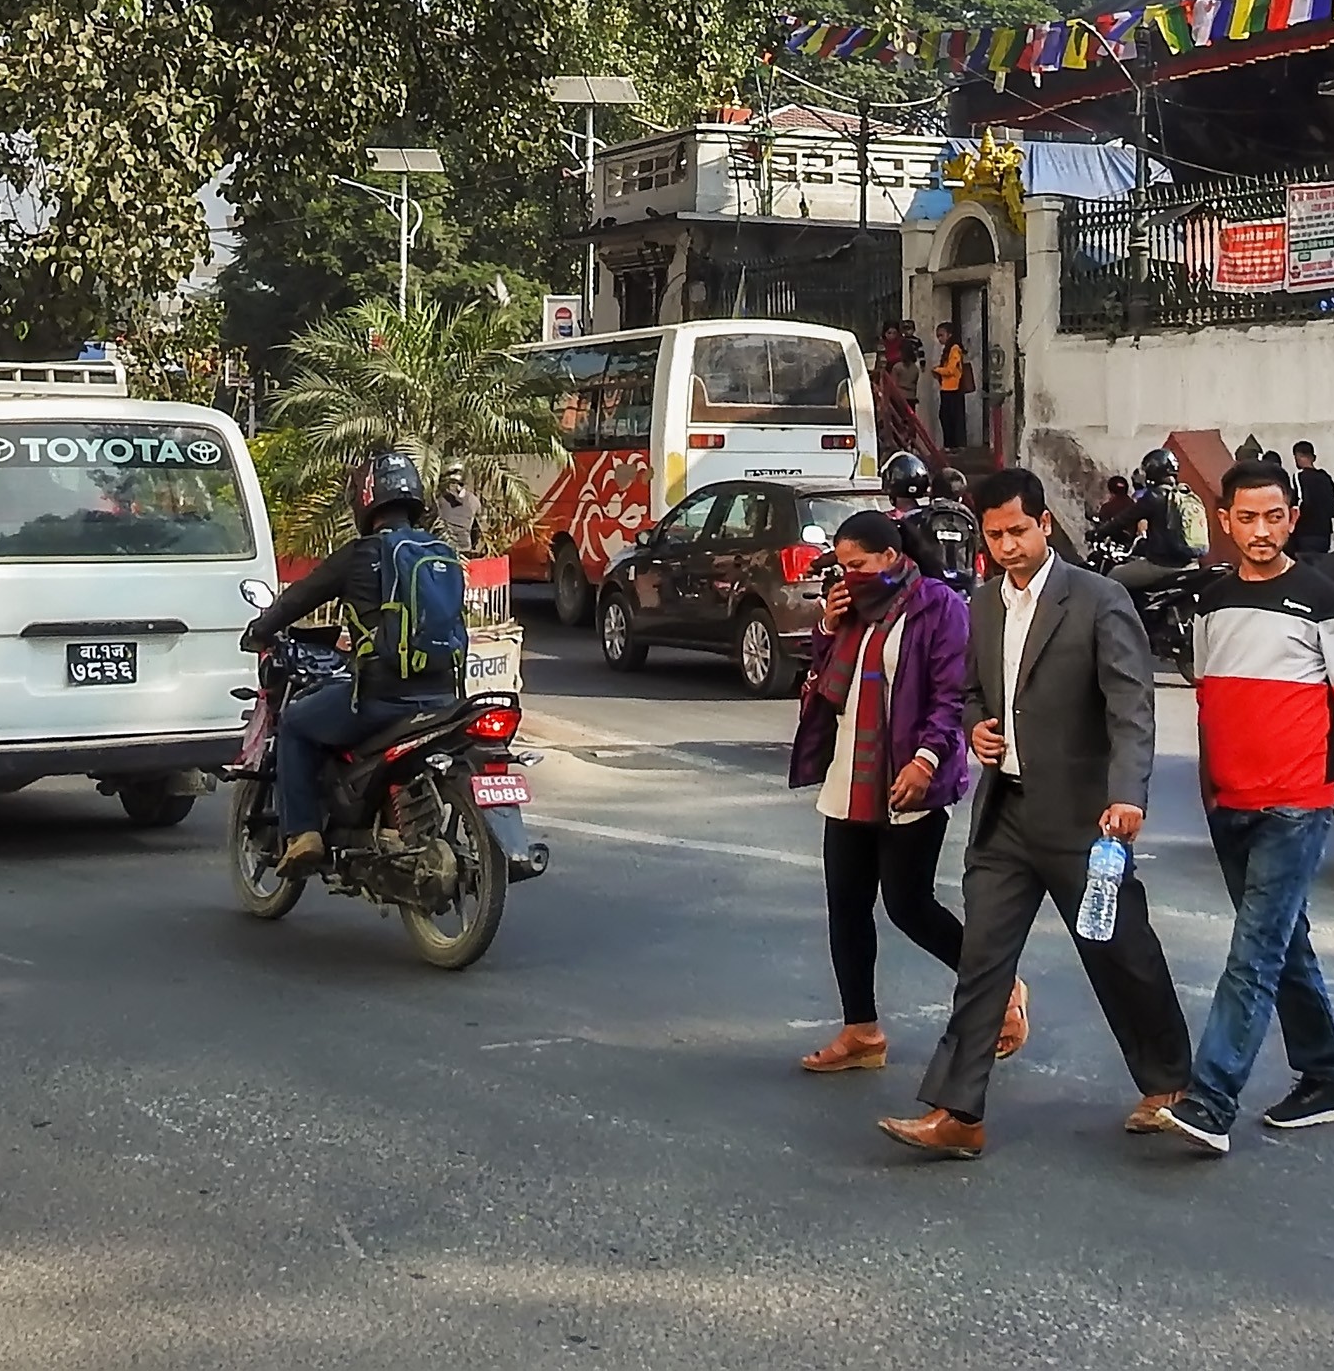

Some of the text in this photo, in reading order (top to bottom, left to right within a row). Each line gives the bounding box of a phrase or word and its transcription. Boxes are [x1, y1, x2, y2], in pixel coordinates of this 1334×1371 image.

[19, 437, 186, 464] TOYOTA
[70, 661, 133, 682] ७८३६
[478, 788, 528, 802] १७४४
